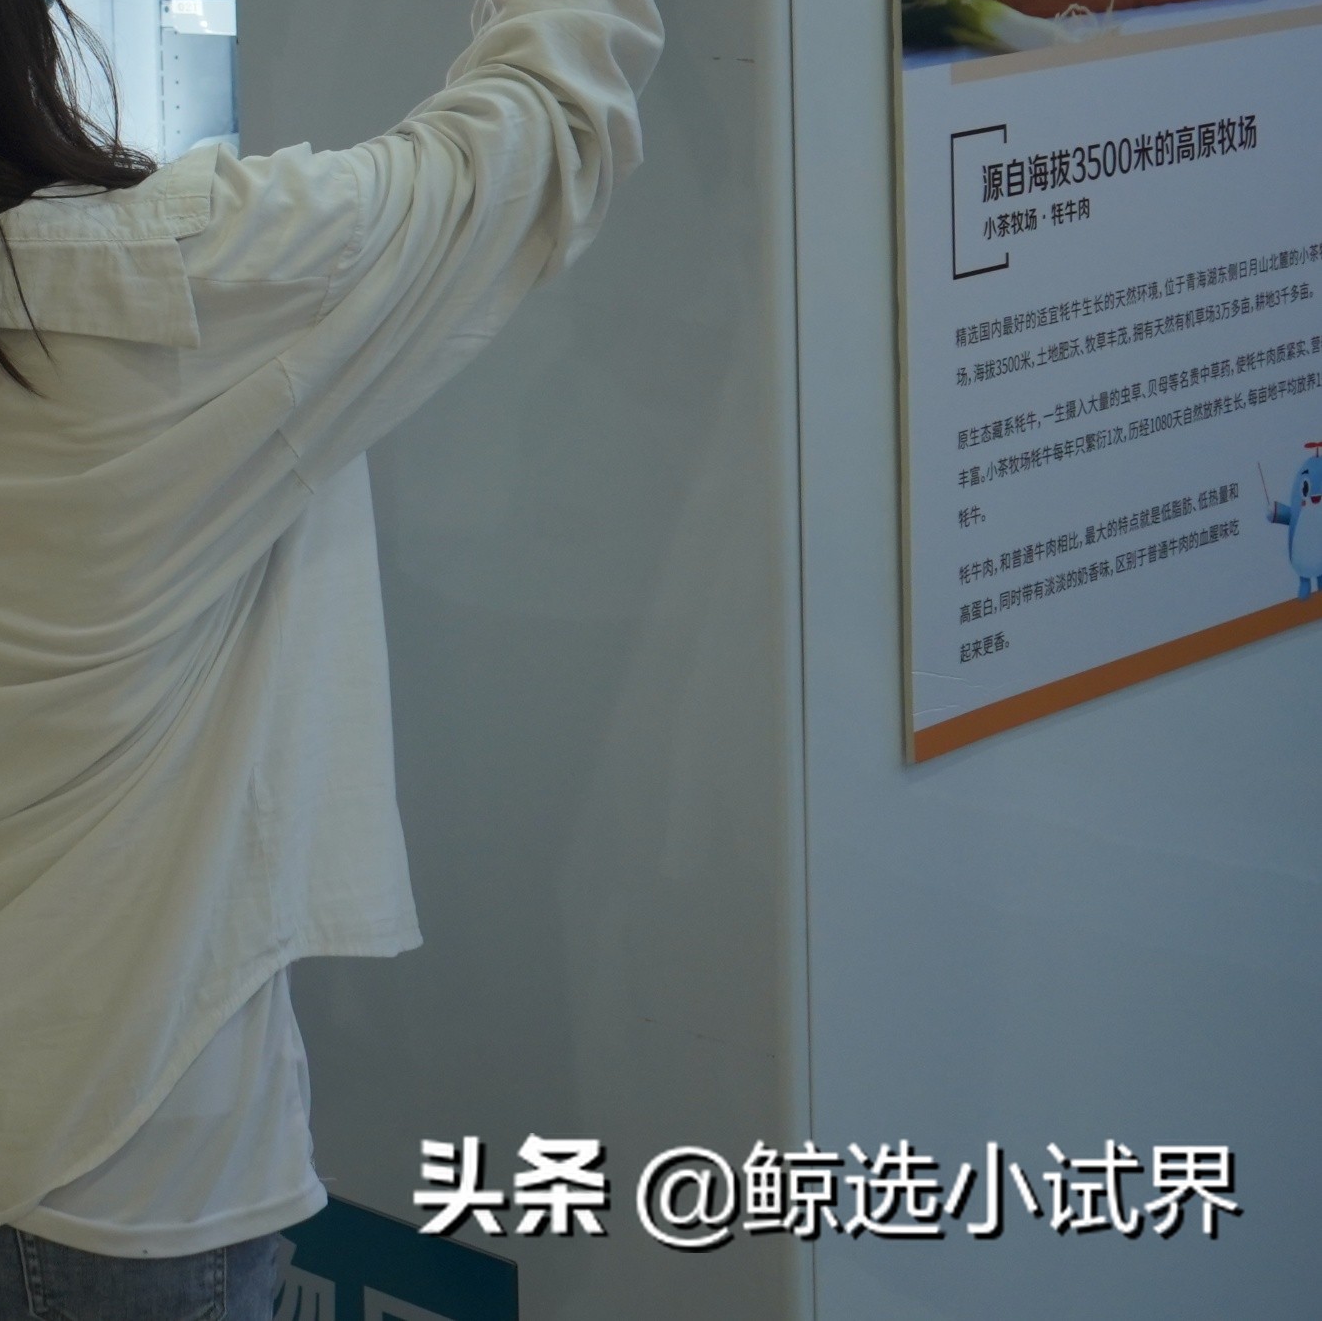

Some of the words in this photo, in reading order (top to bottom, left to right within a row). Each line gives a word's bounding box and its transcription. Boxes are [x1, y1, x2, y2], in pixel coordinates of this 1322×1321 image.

[982, 115, 1258, 203] 源自海拔3500米的高原牧场
[959, 631, 1010, 665] 起来更香。
